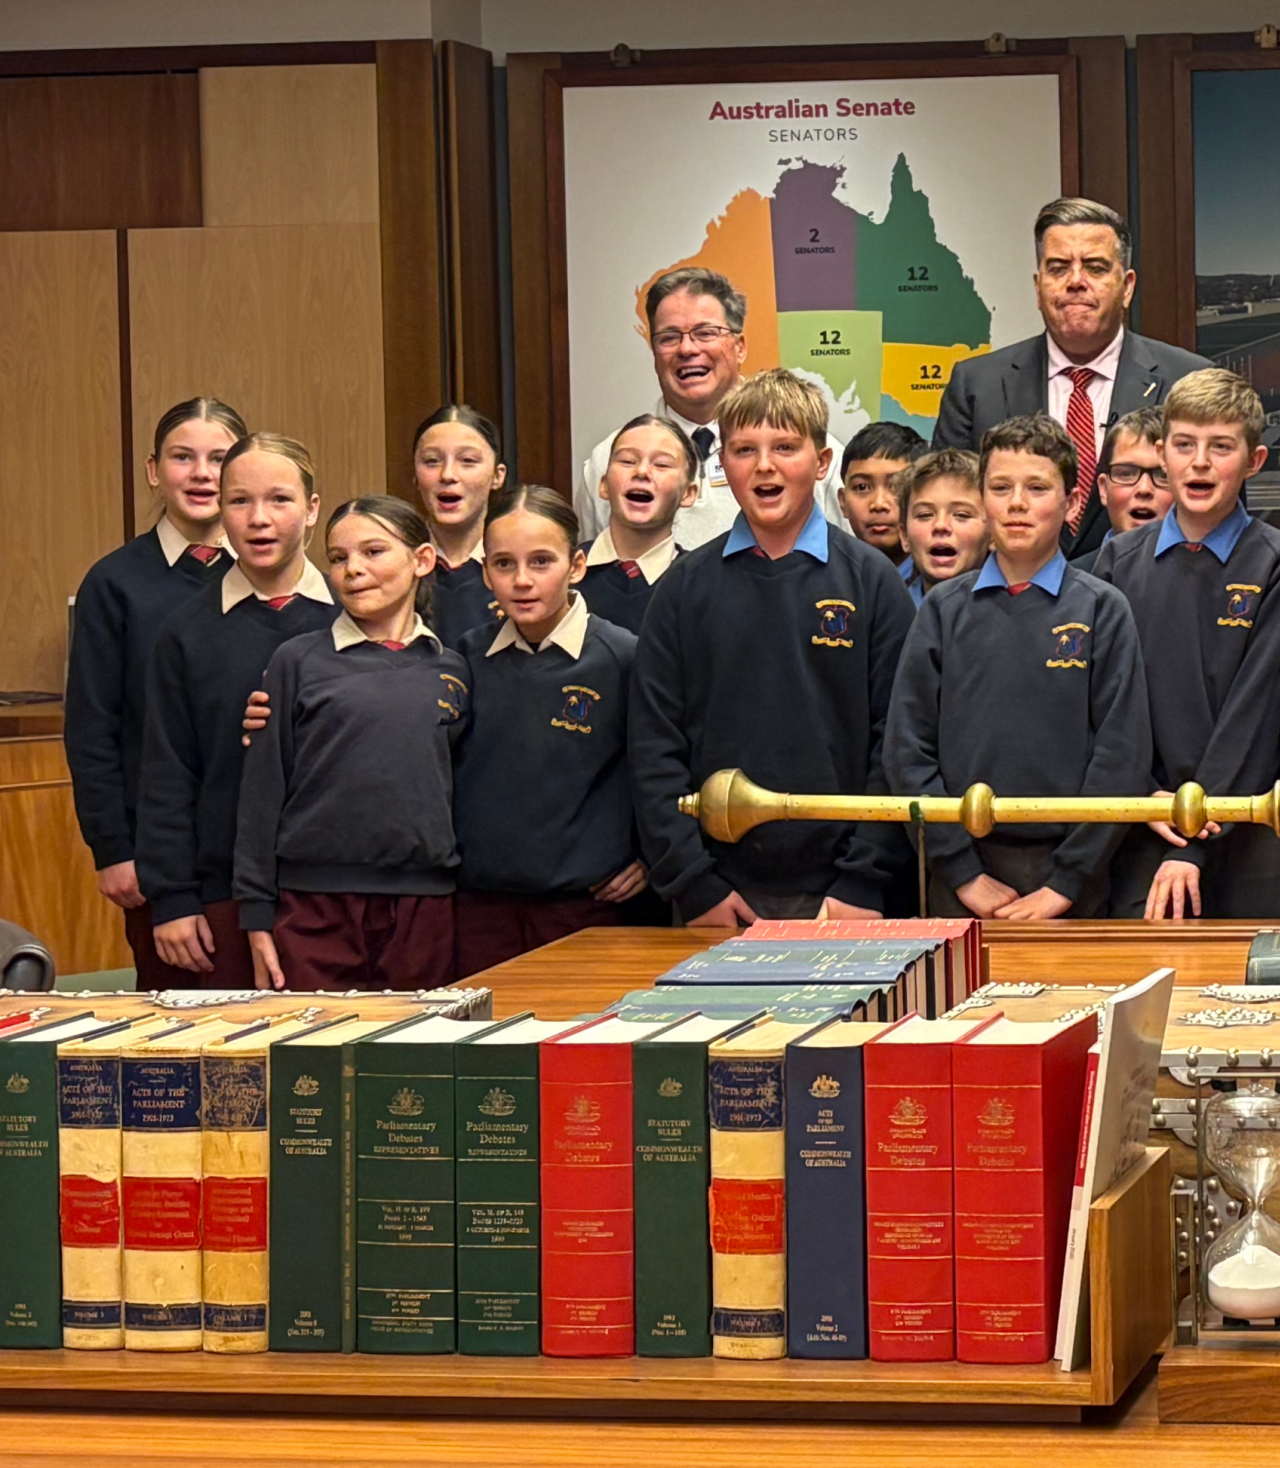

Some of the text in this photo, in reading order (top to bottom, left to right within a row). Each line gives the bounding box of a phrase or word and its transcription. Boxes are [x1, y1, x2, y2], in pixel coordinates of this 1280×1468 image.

[708, 97, 916, 121] Australian Senate
[768, 127, 858, 143] SENATORS
[809, 228, 820, 243] 2
[794, 246, 835, 255] SENATORS
[906, 266, 929, 281] 12
[897, 284, 939, 293] SENATORS
[819, 330, 842, 345] 12
[810, 348, 851, 356] SENATORS
[920, 364, 942, 379] 12
[131, 1088, 187, 1097] ACTS OF THE
[741, 1086, 753, 1096] OF
[132, 1100, 187, 1109] PARLIAMENT
[718, 1099, 773, 1108] PARLIAMENT
[817, 1110, 834, 1118] ACTS
[376, 1120, 437, 1132] Parliamentary
[466, 1121, 529, 1134] Parliamentary
[647, 1119, 692, 1128] STATUTORY
[657, 1128, 682, 1136] RULES
[806, 1125, 845, 1133] PARLIAMENT
[388, 1133, 424, 1143] Debates
[479, 1134, 517, 1145] Debates
[373, 1145, 440, 1154] REPRESENTATIVES
[554, 1140, 614, 1152] Parliamentary
[636, 1145, 703, 1153] COMMONWEALTH
[877, 1142, 939, 1155] Parliamentary
[966, 1142, 1028, 1155] Parliamentary
[564, 1152, 601, 1163] Debates
[655, 1154, 697, 1162] AUSTRALIA
[814, 1158, 847, 1167] AUSTRALIA
[890, 1156, 926, 1167] Debates
[979, 1156, 1015, 1167] Debates
[815, 1323, 834, 1332] Volume
